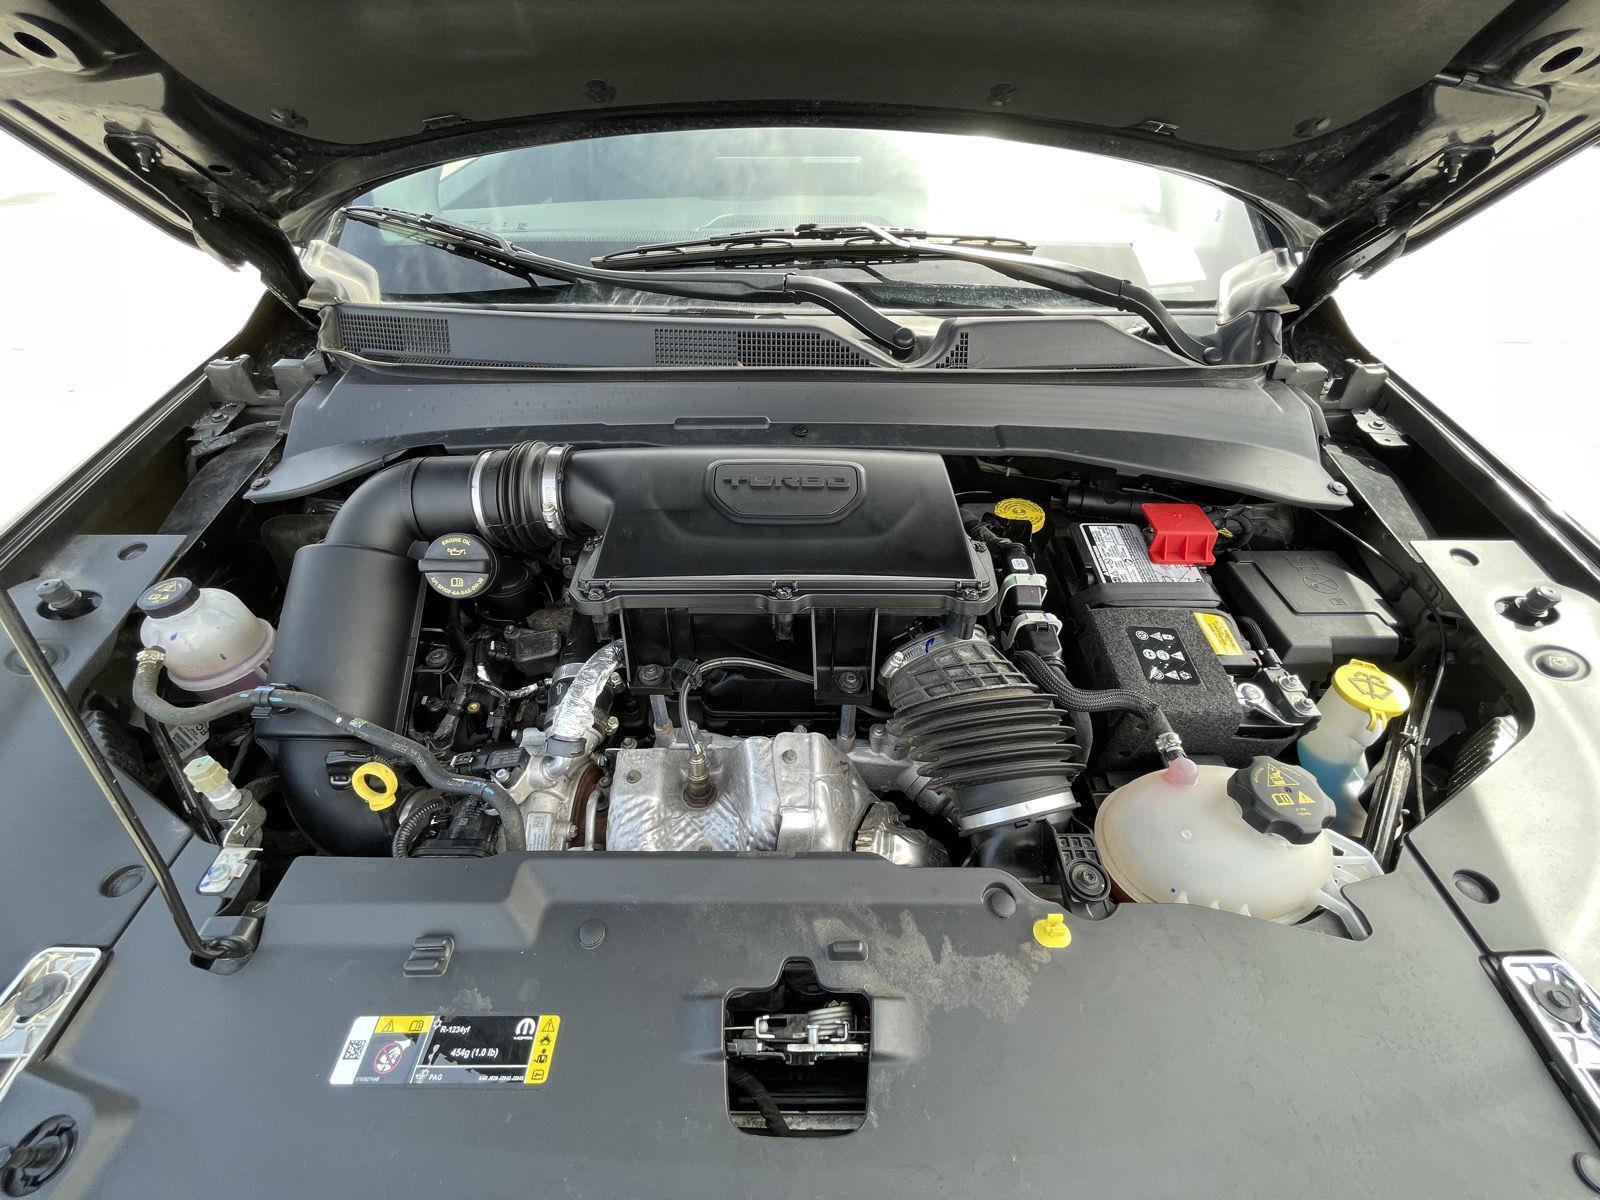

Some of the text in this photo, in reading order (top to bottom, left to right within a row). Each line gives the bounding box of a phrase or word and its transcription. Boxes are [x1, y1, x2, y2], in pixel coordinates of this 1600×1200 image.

[722, 475, 851, 490] TURBO
[442, 538, 471, 546] ENGINE OIL
[440, 1026, 471, 1035] R-1234yf
[450, 1048, 499, 1058] 454g (1.0 lb)
